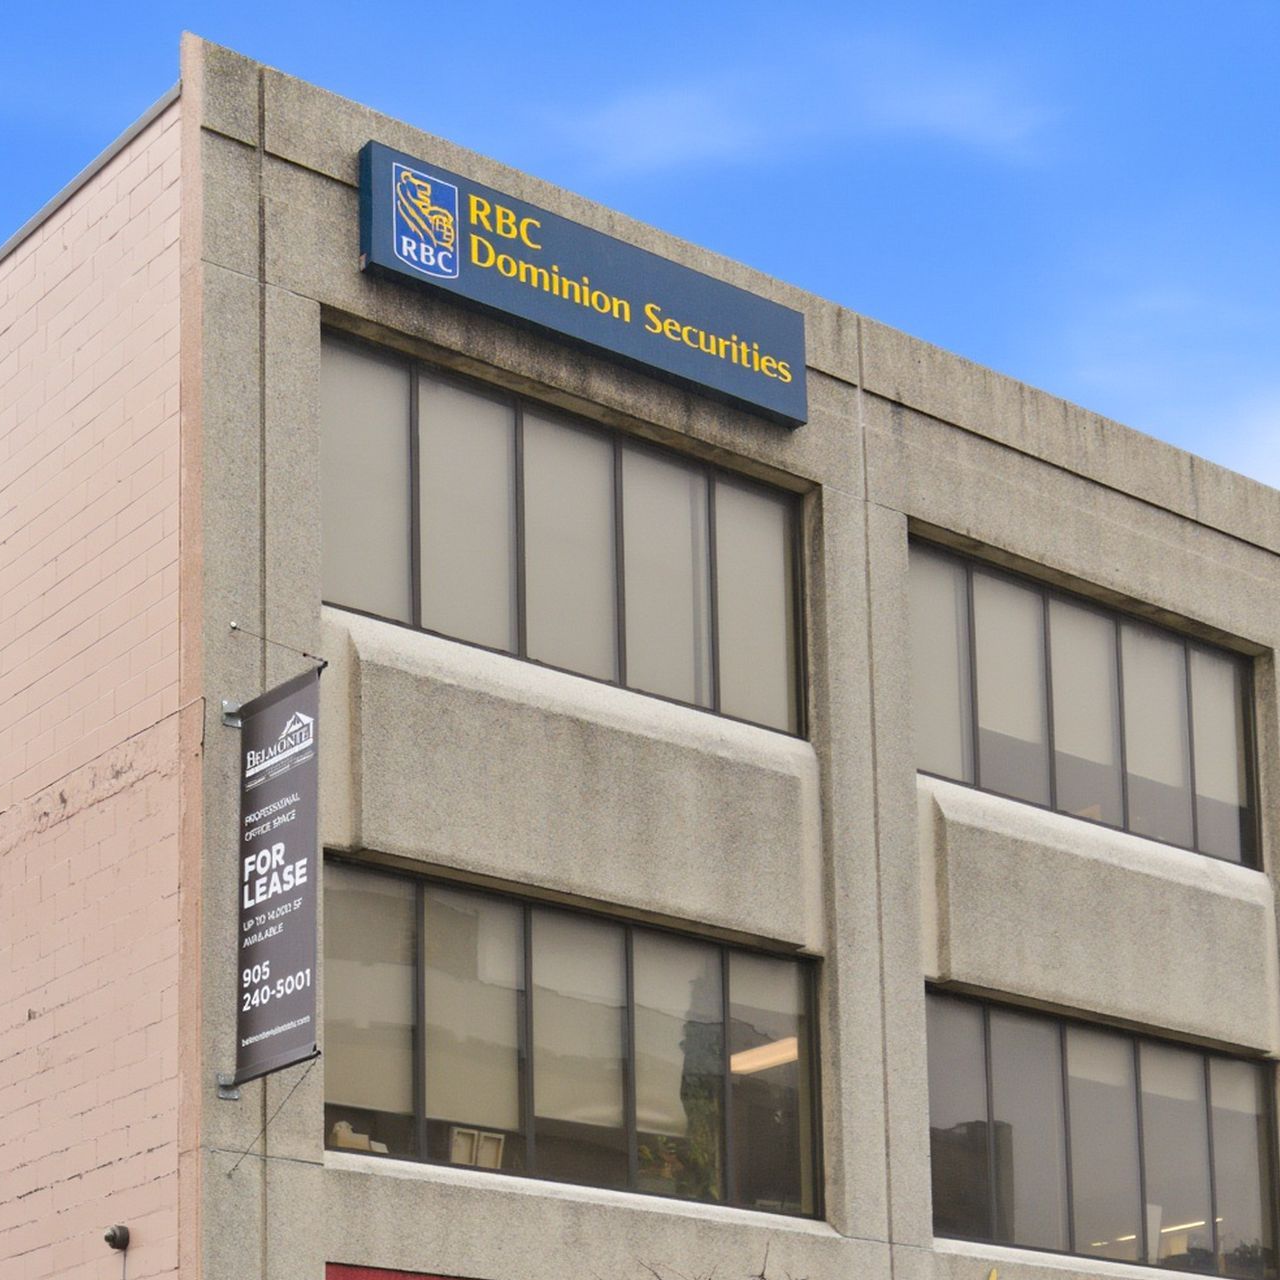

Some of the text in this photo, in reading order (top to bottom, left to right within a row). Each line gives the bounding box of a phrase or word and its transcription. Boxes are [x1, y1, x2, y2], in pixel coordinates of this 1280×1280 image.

[468, 194, 542, 251] RBC
[401, 236, 453, 275] RBC
[470, 233, 793, 384] Dominion Securities
[243, 857, 308, 909] LEASE
[244, 842, 285, 882] FOR
[242, 968, 312, 1012] 240-5001
[243, 960, 271, 988] 905
